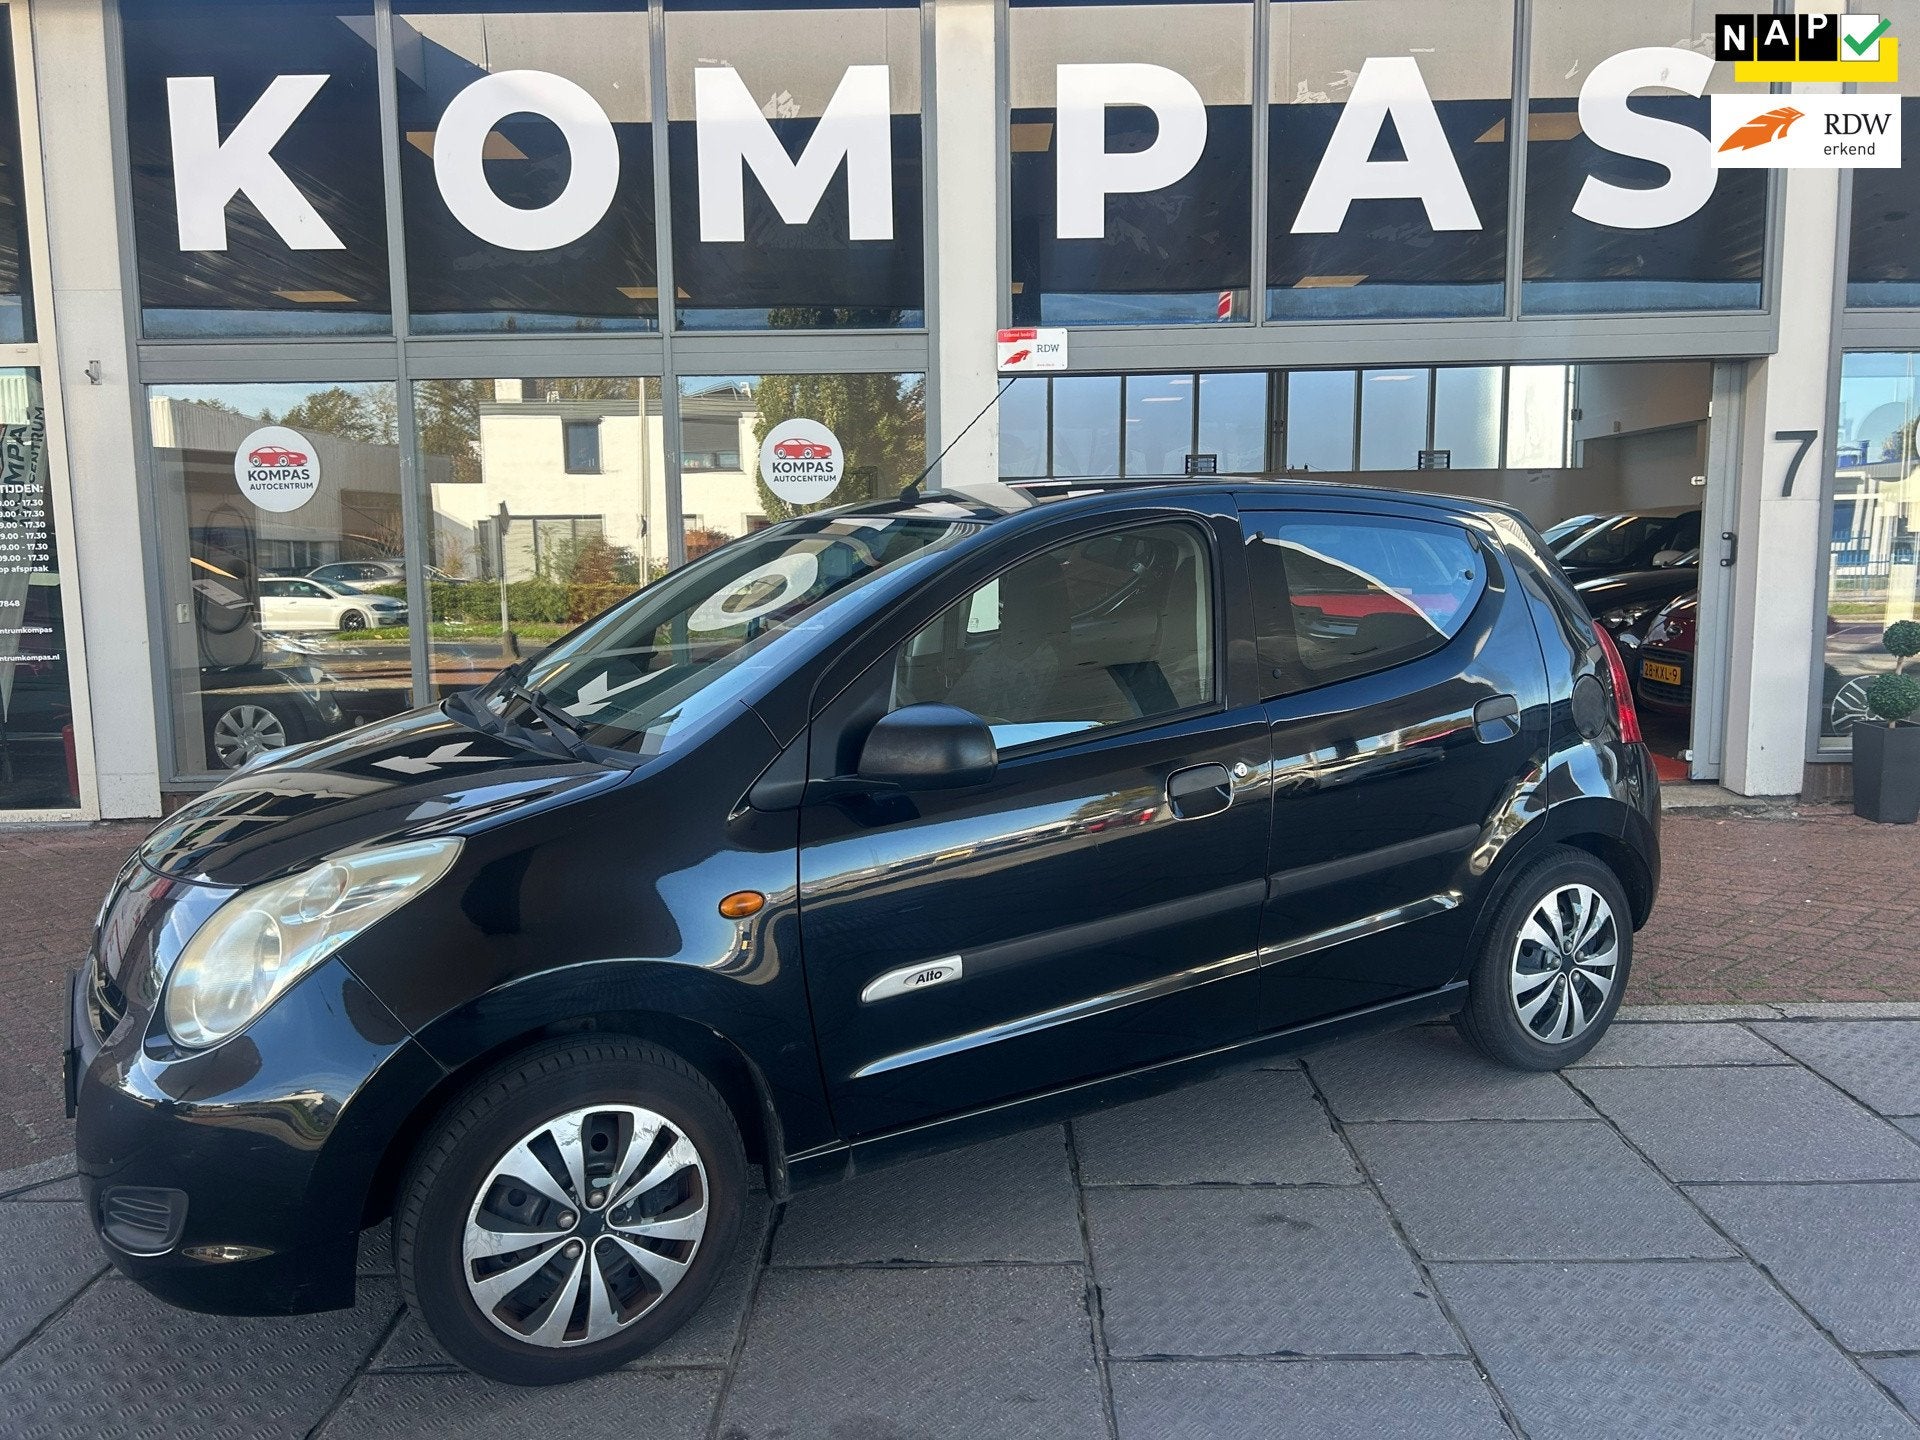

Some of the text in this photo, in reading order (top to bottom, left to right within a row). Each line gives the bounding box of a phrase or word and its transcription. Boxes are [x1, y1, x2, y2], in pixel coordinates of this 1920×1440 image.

[166, 46, 1719, 251] KOMPAS
[1036, 344, 1060, 353] RDW
[773, 461, 834, 473] KOMPAS
[1774, 430, 1818, 497] 7
[248, 469, 310, 481] KOMPAS
[250, 482, 314, 490] AUTOCENTRUM
[25, 532, 47, 540] 17.30
[26, 543, 48, 551] 17.30
[11, 564, 49, 574] afspraak
[915, 970, 943, 985] Alto
